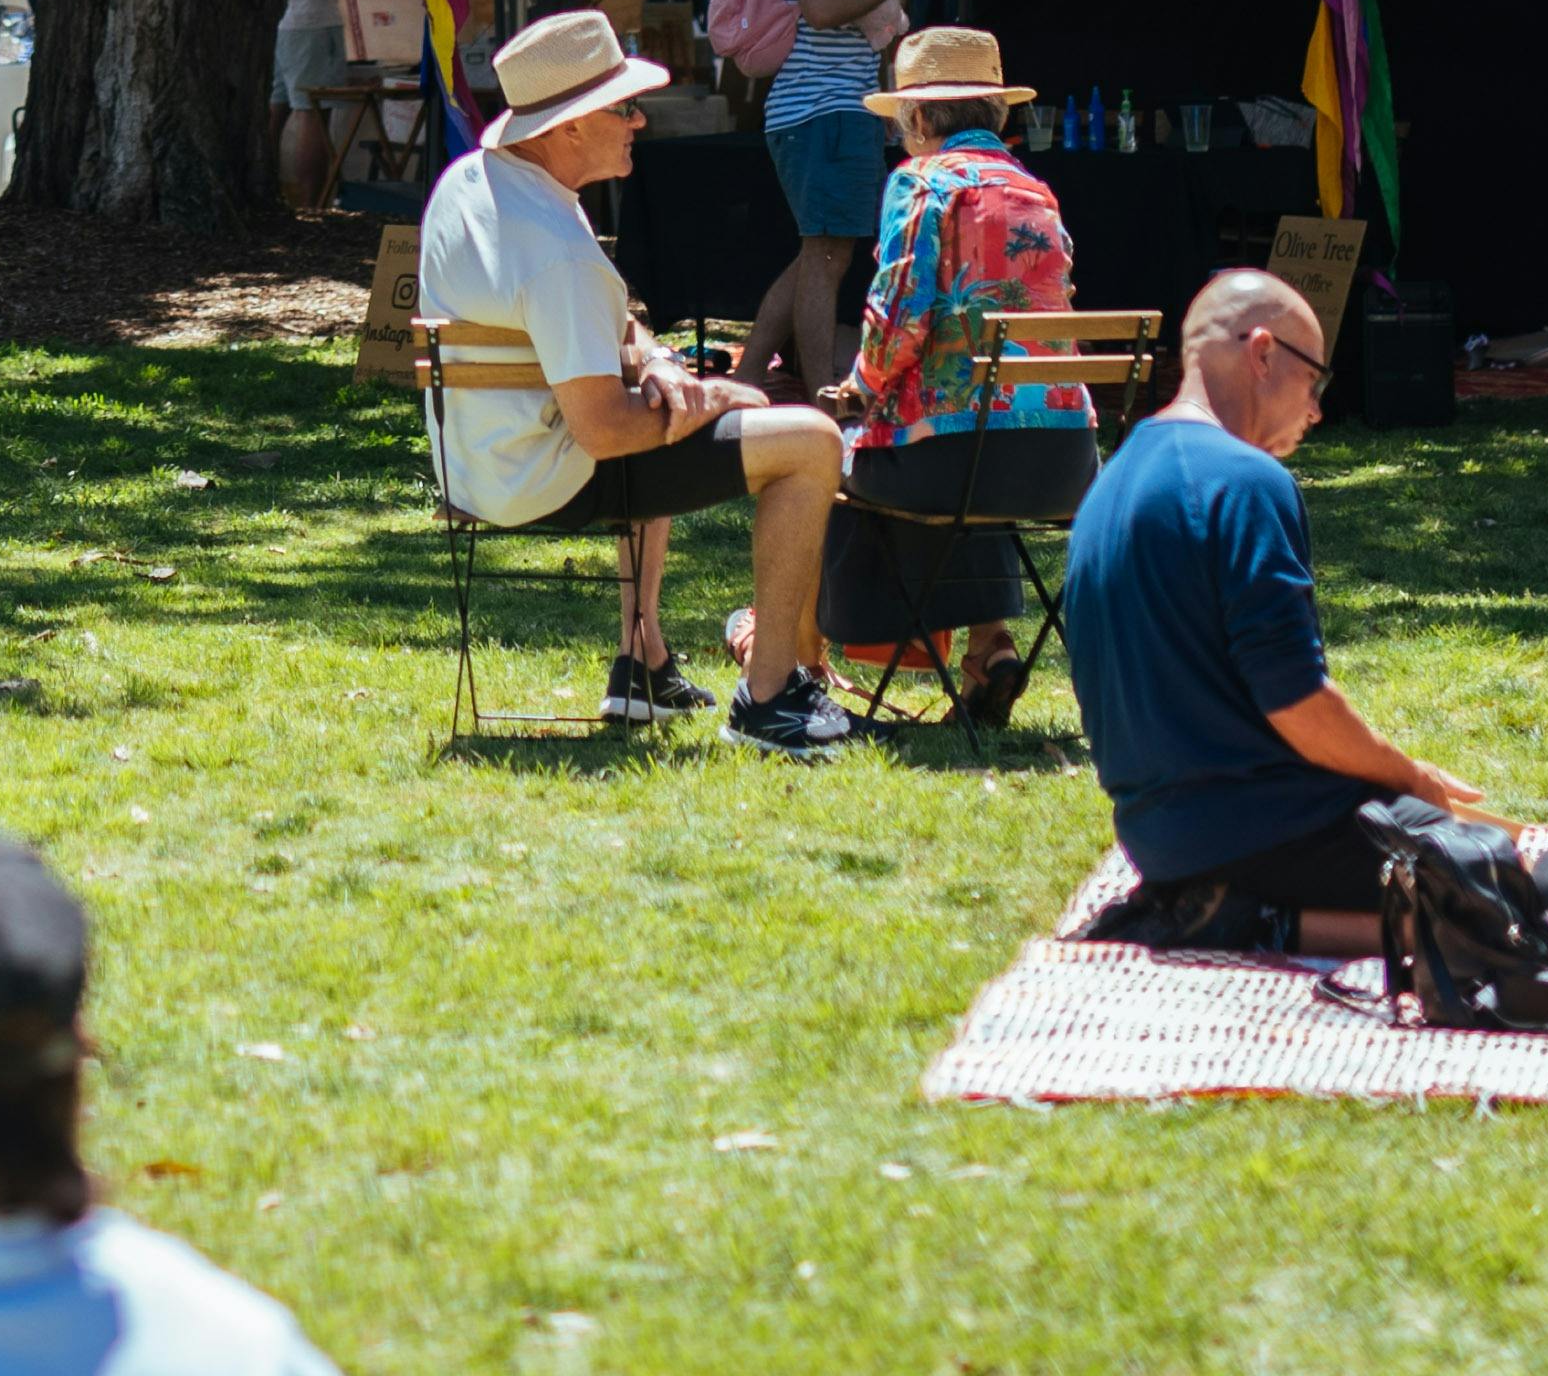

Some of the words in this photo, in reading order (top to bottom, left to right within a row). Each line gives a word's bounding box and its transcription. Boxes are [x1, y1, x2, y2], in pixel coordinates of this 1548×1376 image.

[387, 240, 421, 255] Follo
[1275, 231, 1317, 259] Olive
[1323, 233, 1355, 261] Tree
[1301, 272, 1333, 293] Office
[363, 322, 415, 352] Instagr
